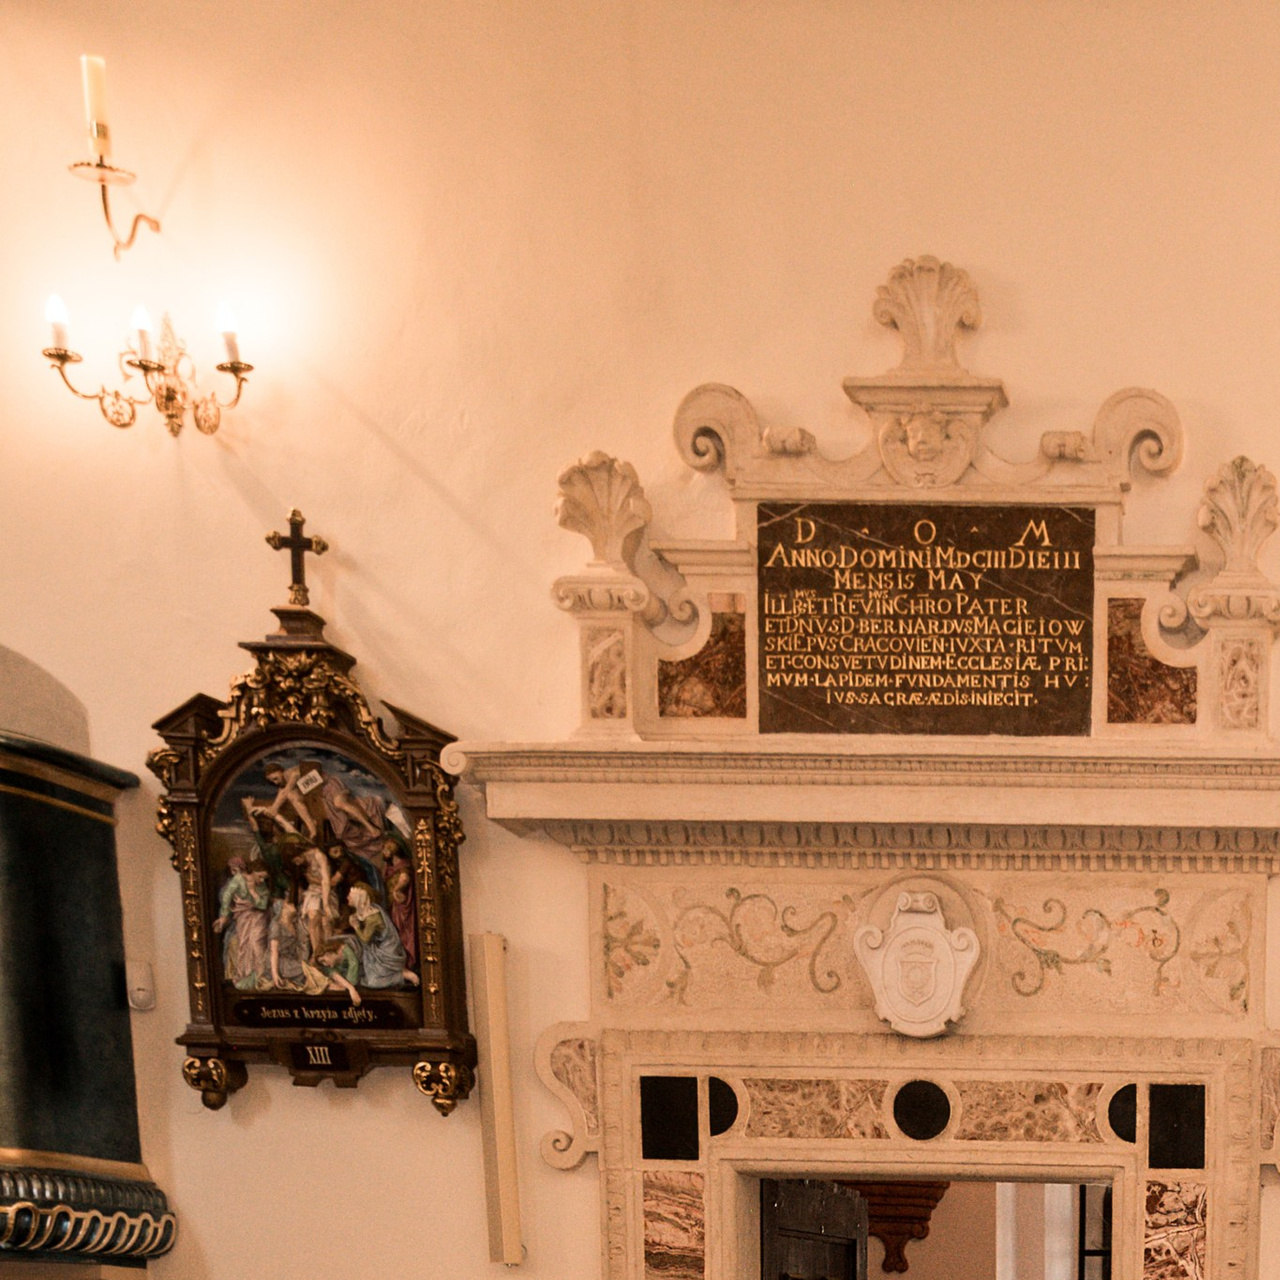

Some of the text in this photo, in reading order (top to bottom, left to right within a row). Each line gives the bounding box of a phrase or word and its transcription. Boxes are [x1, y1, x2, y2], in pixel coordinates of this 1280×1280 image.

[795, 517, 1052, 546] D O M
[260, 1006, 291, 1019] Jezus
[293, 1009, 300, 1019] z
[306, 1046, 332, 1065] XIII
